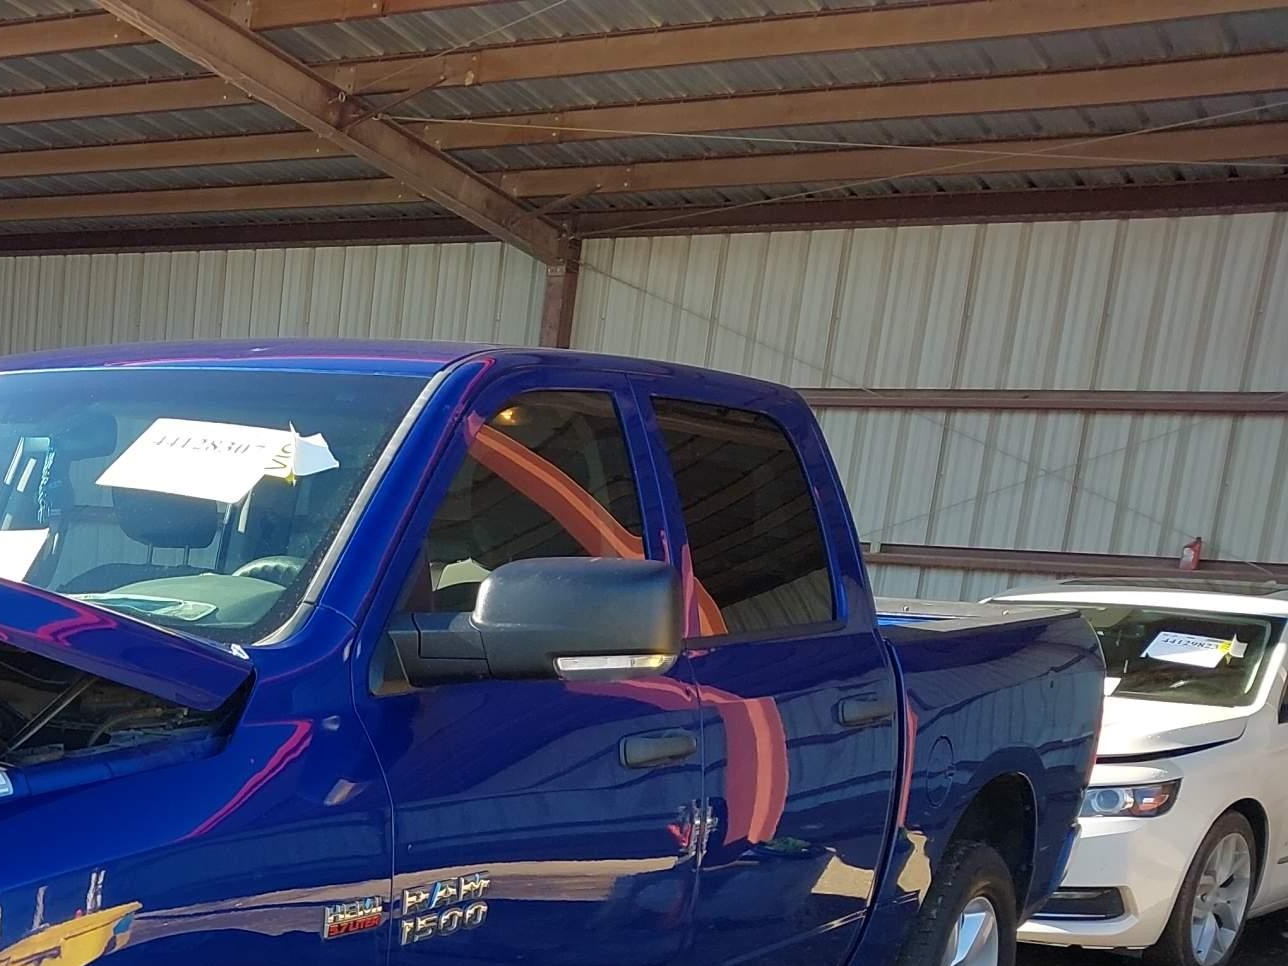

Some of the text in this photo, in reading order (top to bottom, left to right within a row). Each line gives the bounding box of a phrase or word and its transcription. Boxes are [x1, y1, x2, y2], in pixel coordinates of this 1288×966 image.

[326, 896, 384, 923] HEMI
[401, 872, 491, 915] RAM
[400, 901, 489, 945] 1500
